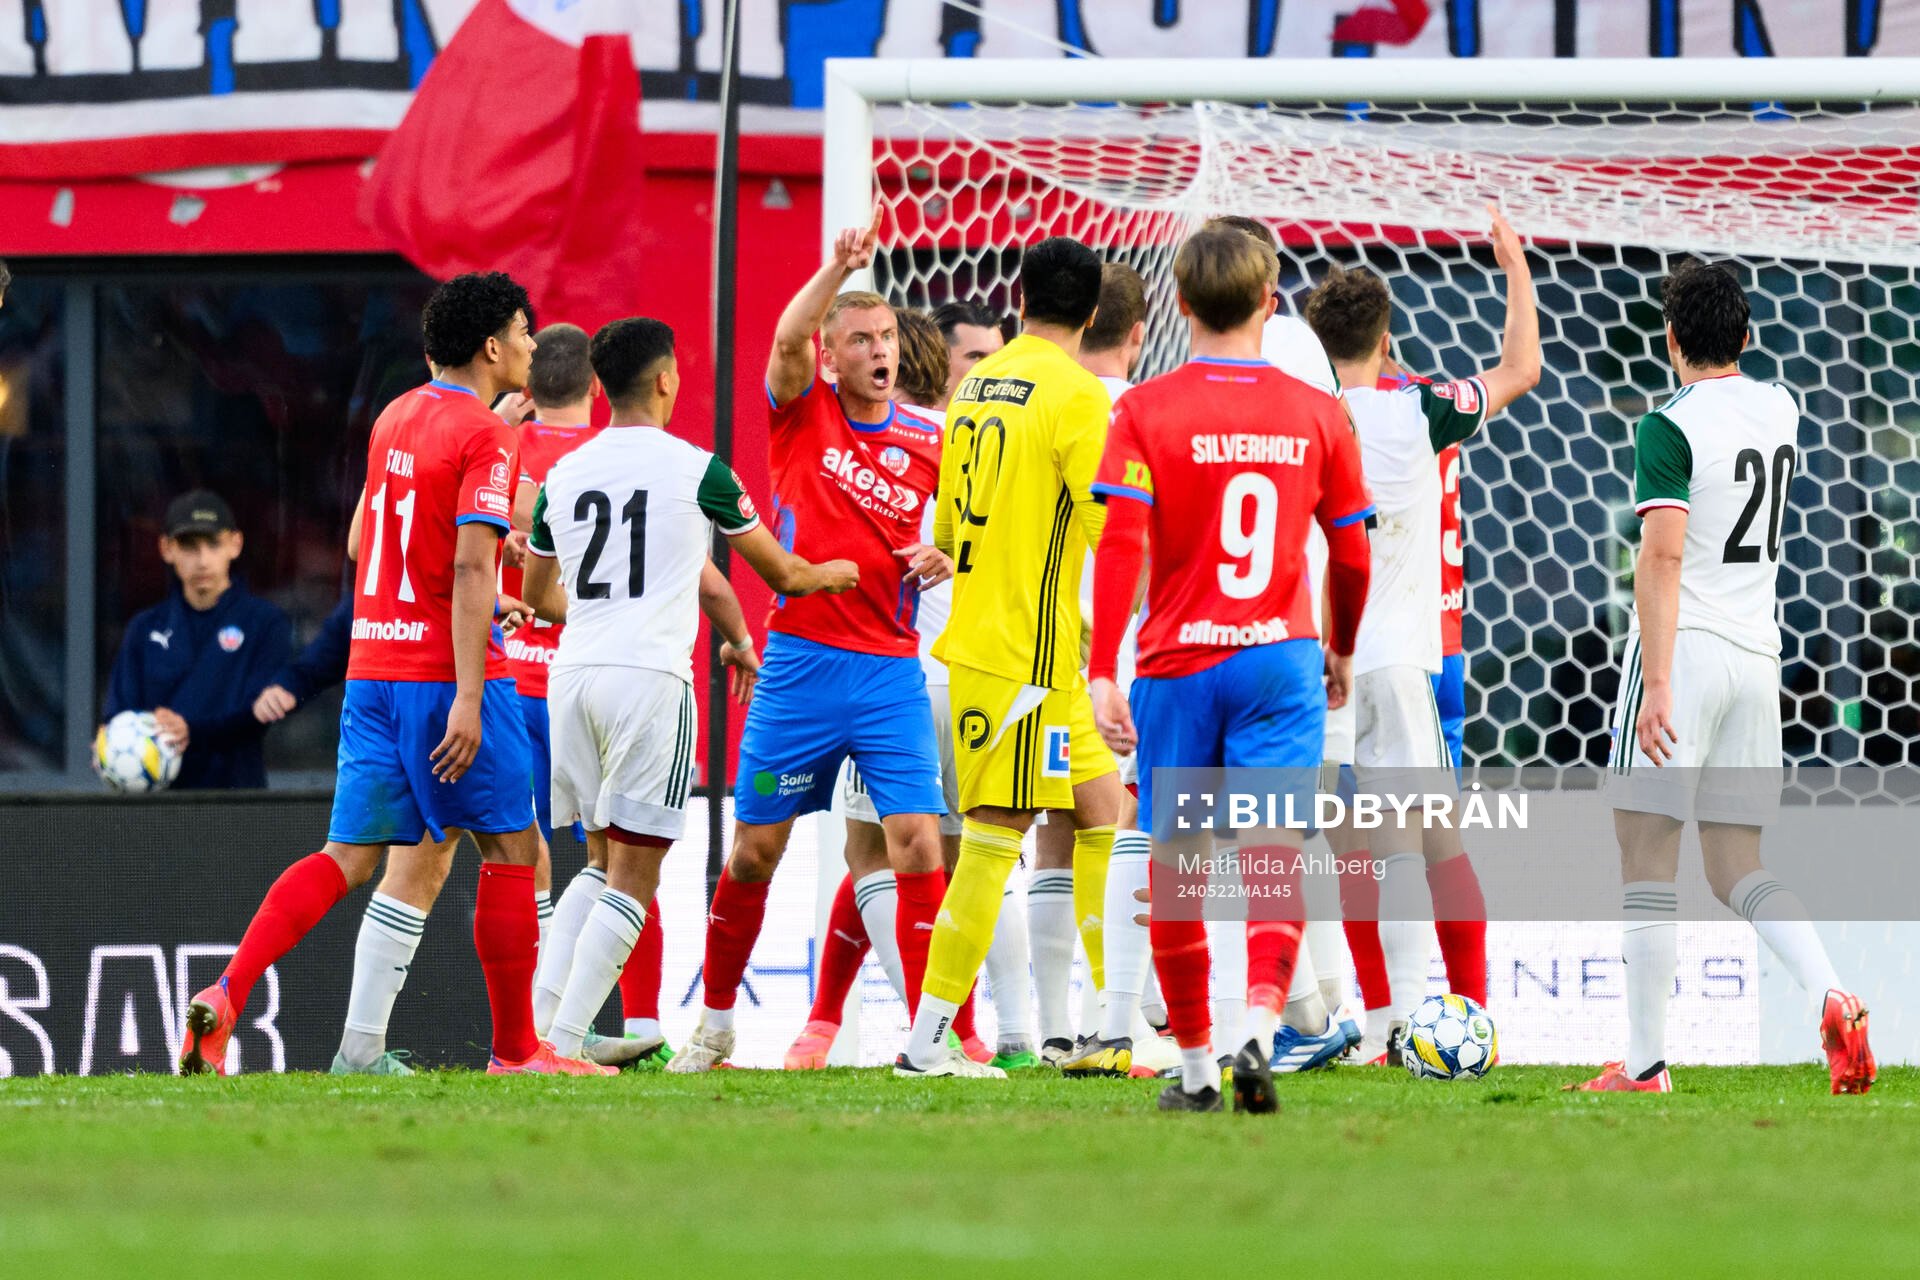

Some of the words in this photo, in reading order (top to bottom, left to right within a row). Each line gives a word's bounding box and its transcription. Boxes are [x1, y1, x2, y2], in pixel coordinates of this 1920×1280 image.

[386, 448, 414, 480] SILVA
[822, 447, 892, 503] akea
[1191, 433, 1310, 466] SILVERHOLT
[1722, 444, 1796, 564] 20
[363, 482, 416, 603] 11
[573, 489, 649, 600] 21
[1217, 471, 1279, 600] 9
[1178, 617, 1289, 647] tillmobil
[780, 773, 815, 787] Solid
